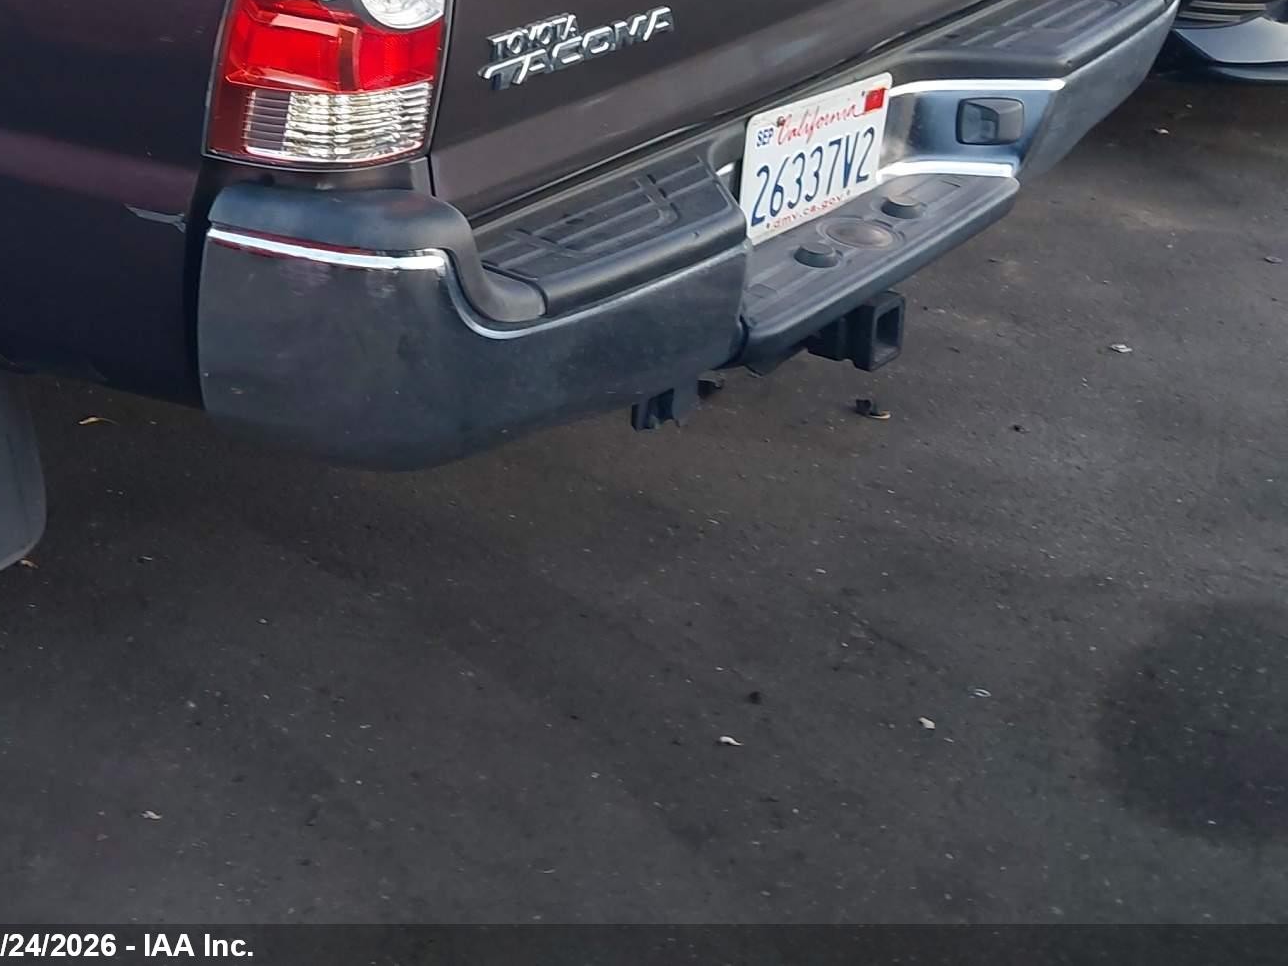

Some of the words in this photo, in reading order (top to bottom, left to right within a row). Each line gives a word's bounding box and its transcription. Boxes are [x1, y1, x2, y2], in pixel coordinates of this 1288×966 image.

[478, 6, 674, 90] TACOMA
[486, 13, 580, 60] TOYOTA
[756, 127, 775, 148] SEP
[776, 102, 866, 146] California
[751, 126, 875, 227] 26337V2
